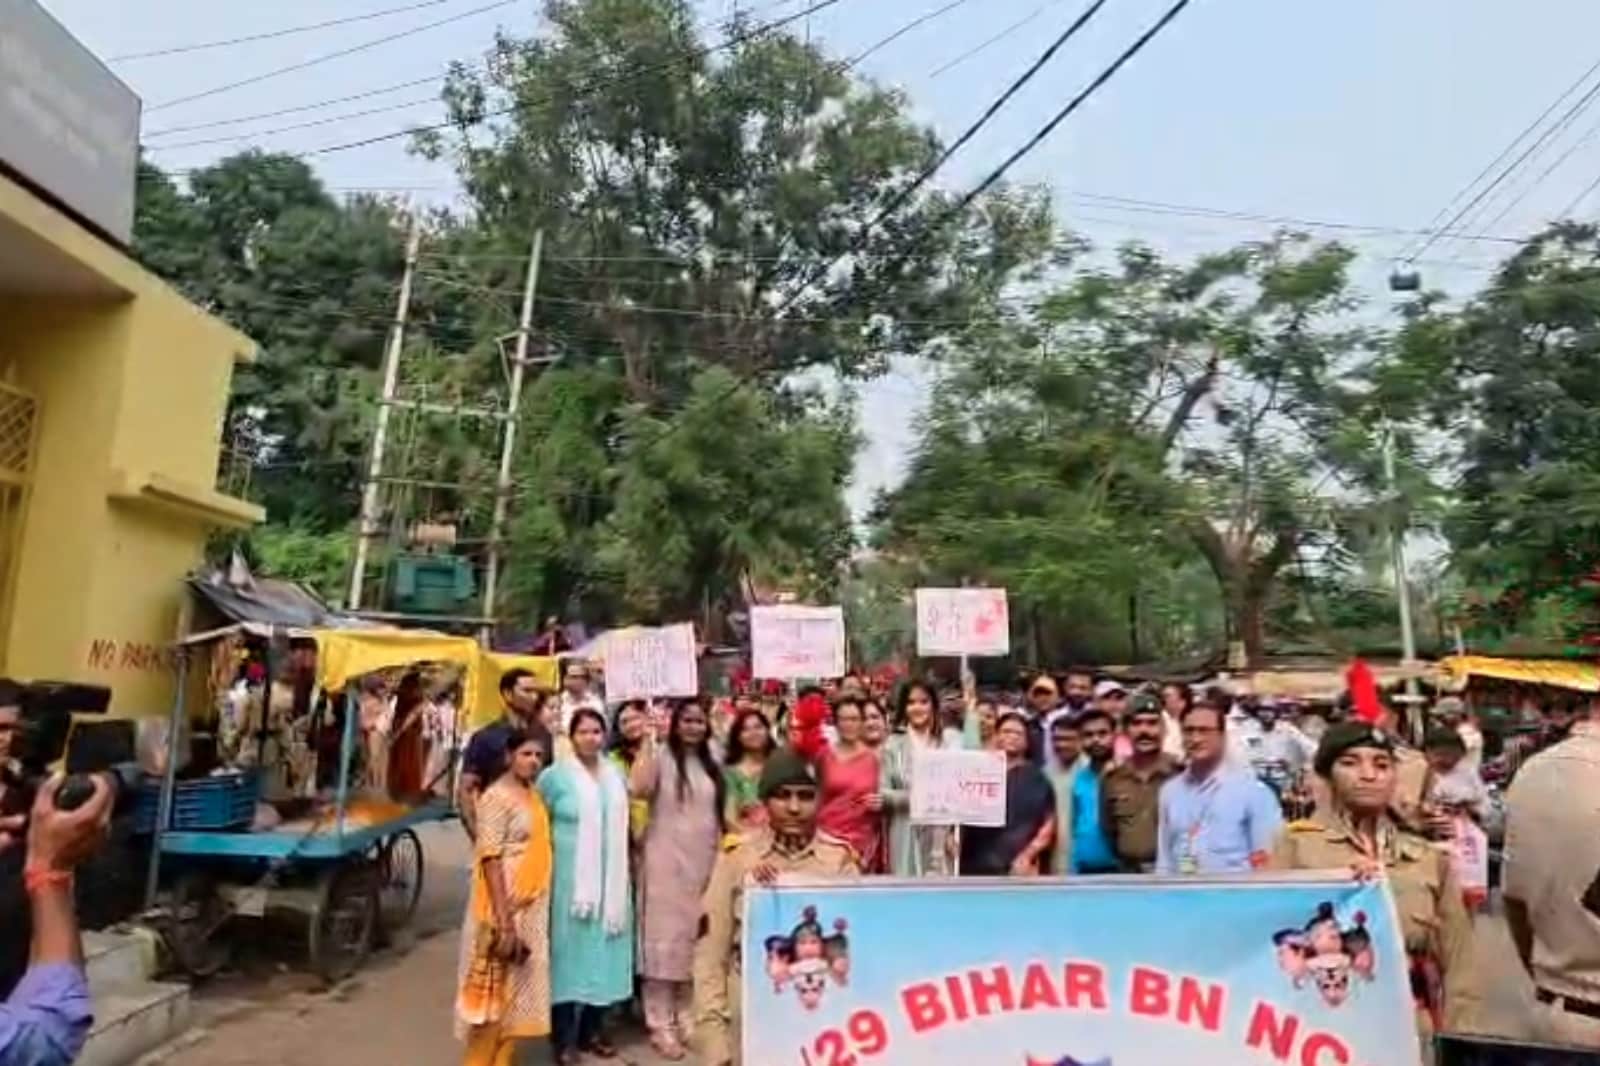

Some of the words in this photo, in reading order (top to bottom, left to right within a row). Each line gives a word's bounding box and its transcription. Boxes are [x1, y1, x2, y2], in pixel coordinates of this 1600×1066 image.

[87, 639, 117, 670] NO
[814, 1010, 888, 1066] 29
[901, 962, 1107, 1033] BIHAR
[1129, 967, 1224, 1031] BN
